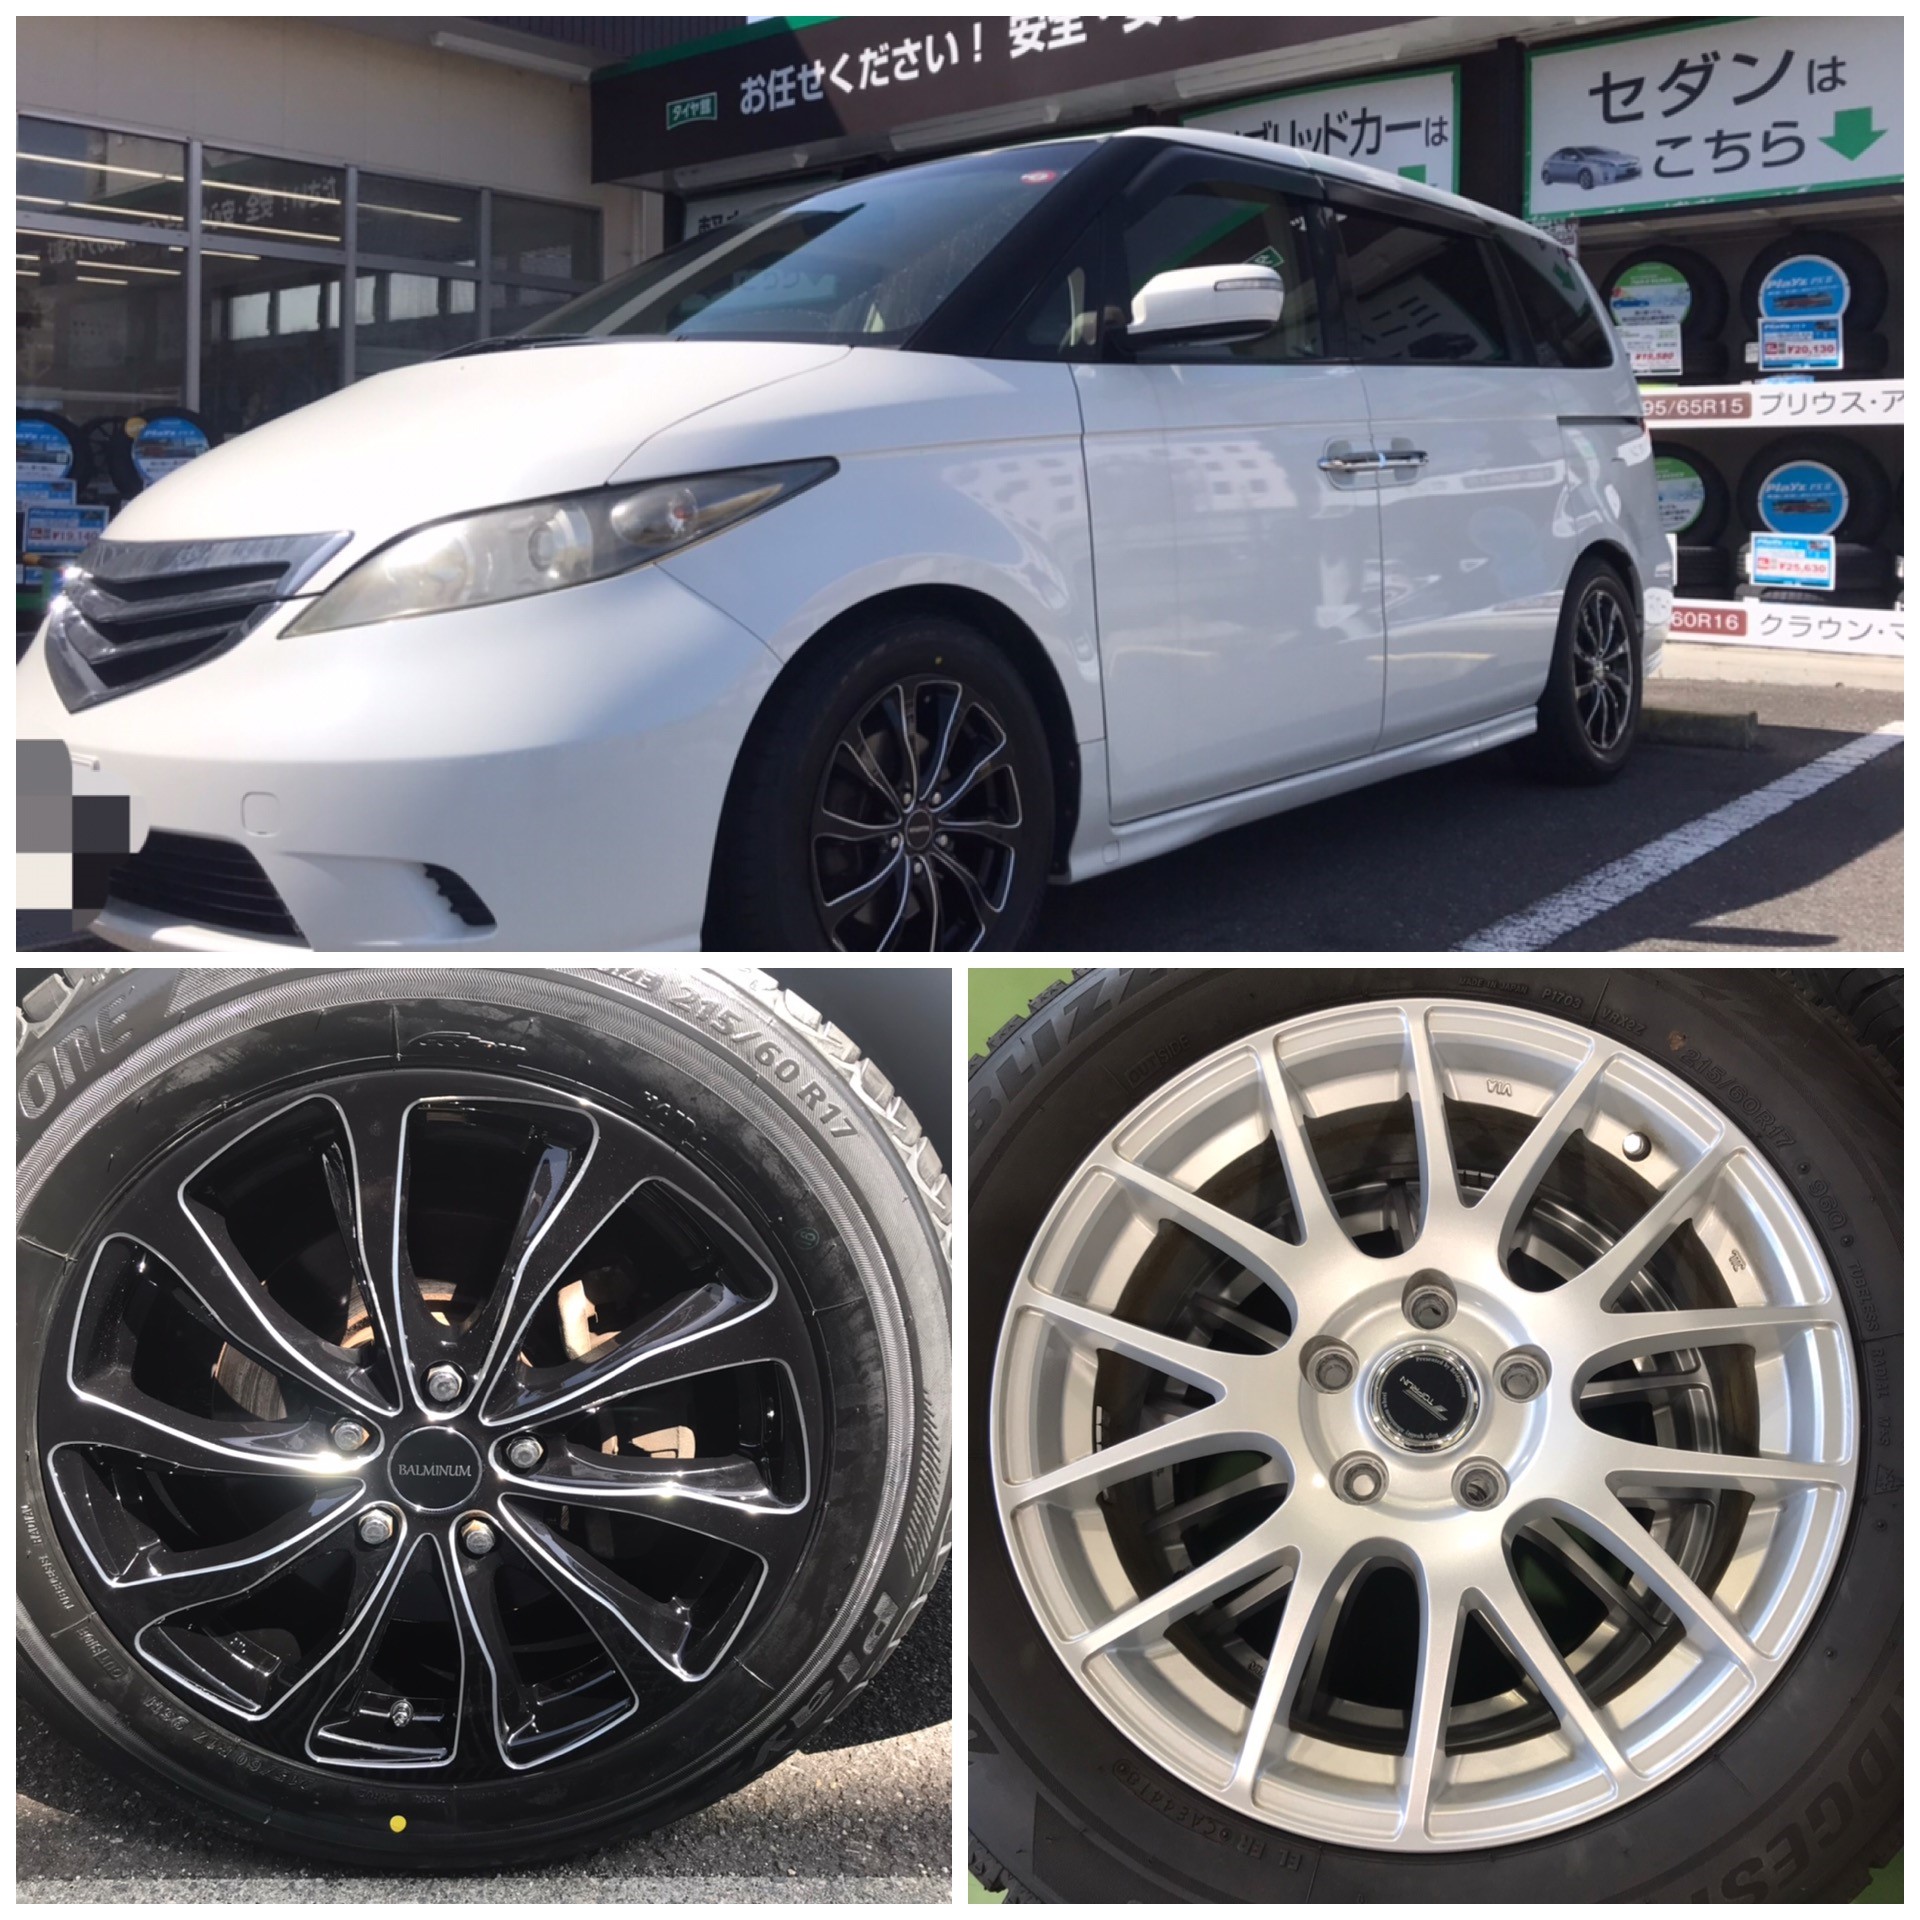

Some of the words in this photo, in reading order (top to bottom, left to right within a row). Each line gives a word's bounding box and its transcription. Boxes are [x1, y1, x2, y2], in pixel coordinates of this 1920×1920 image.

[739, 22, 984, 116] お任せください！
[1589, 49, 1847, 126] セダンは
[1652, 120, 1807, 179] こちら
[398, 1463, 472, 1478] BALMINUM
